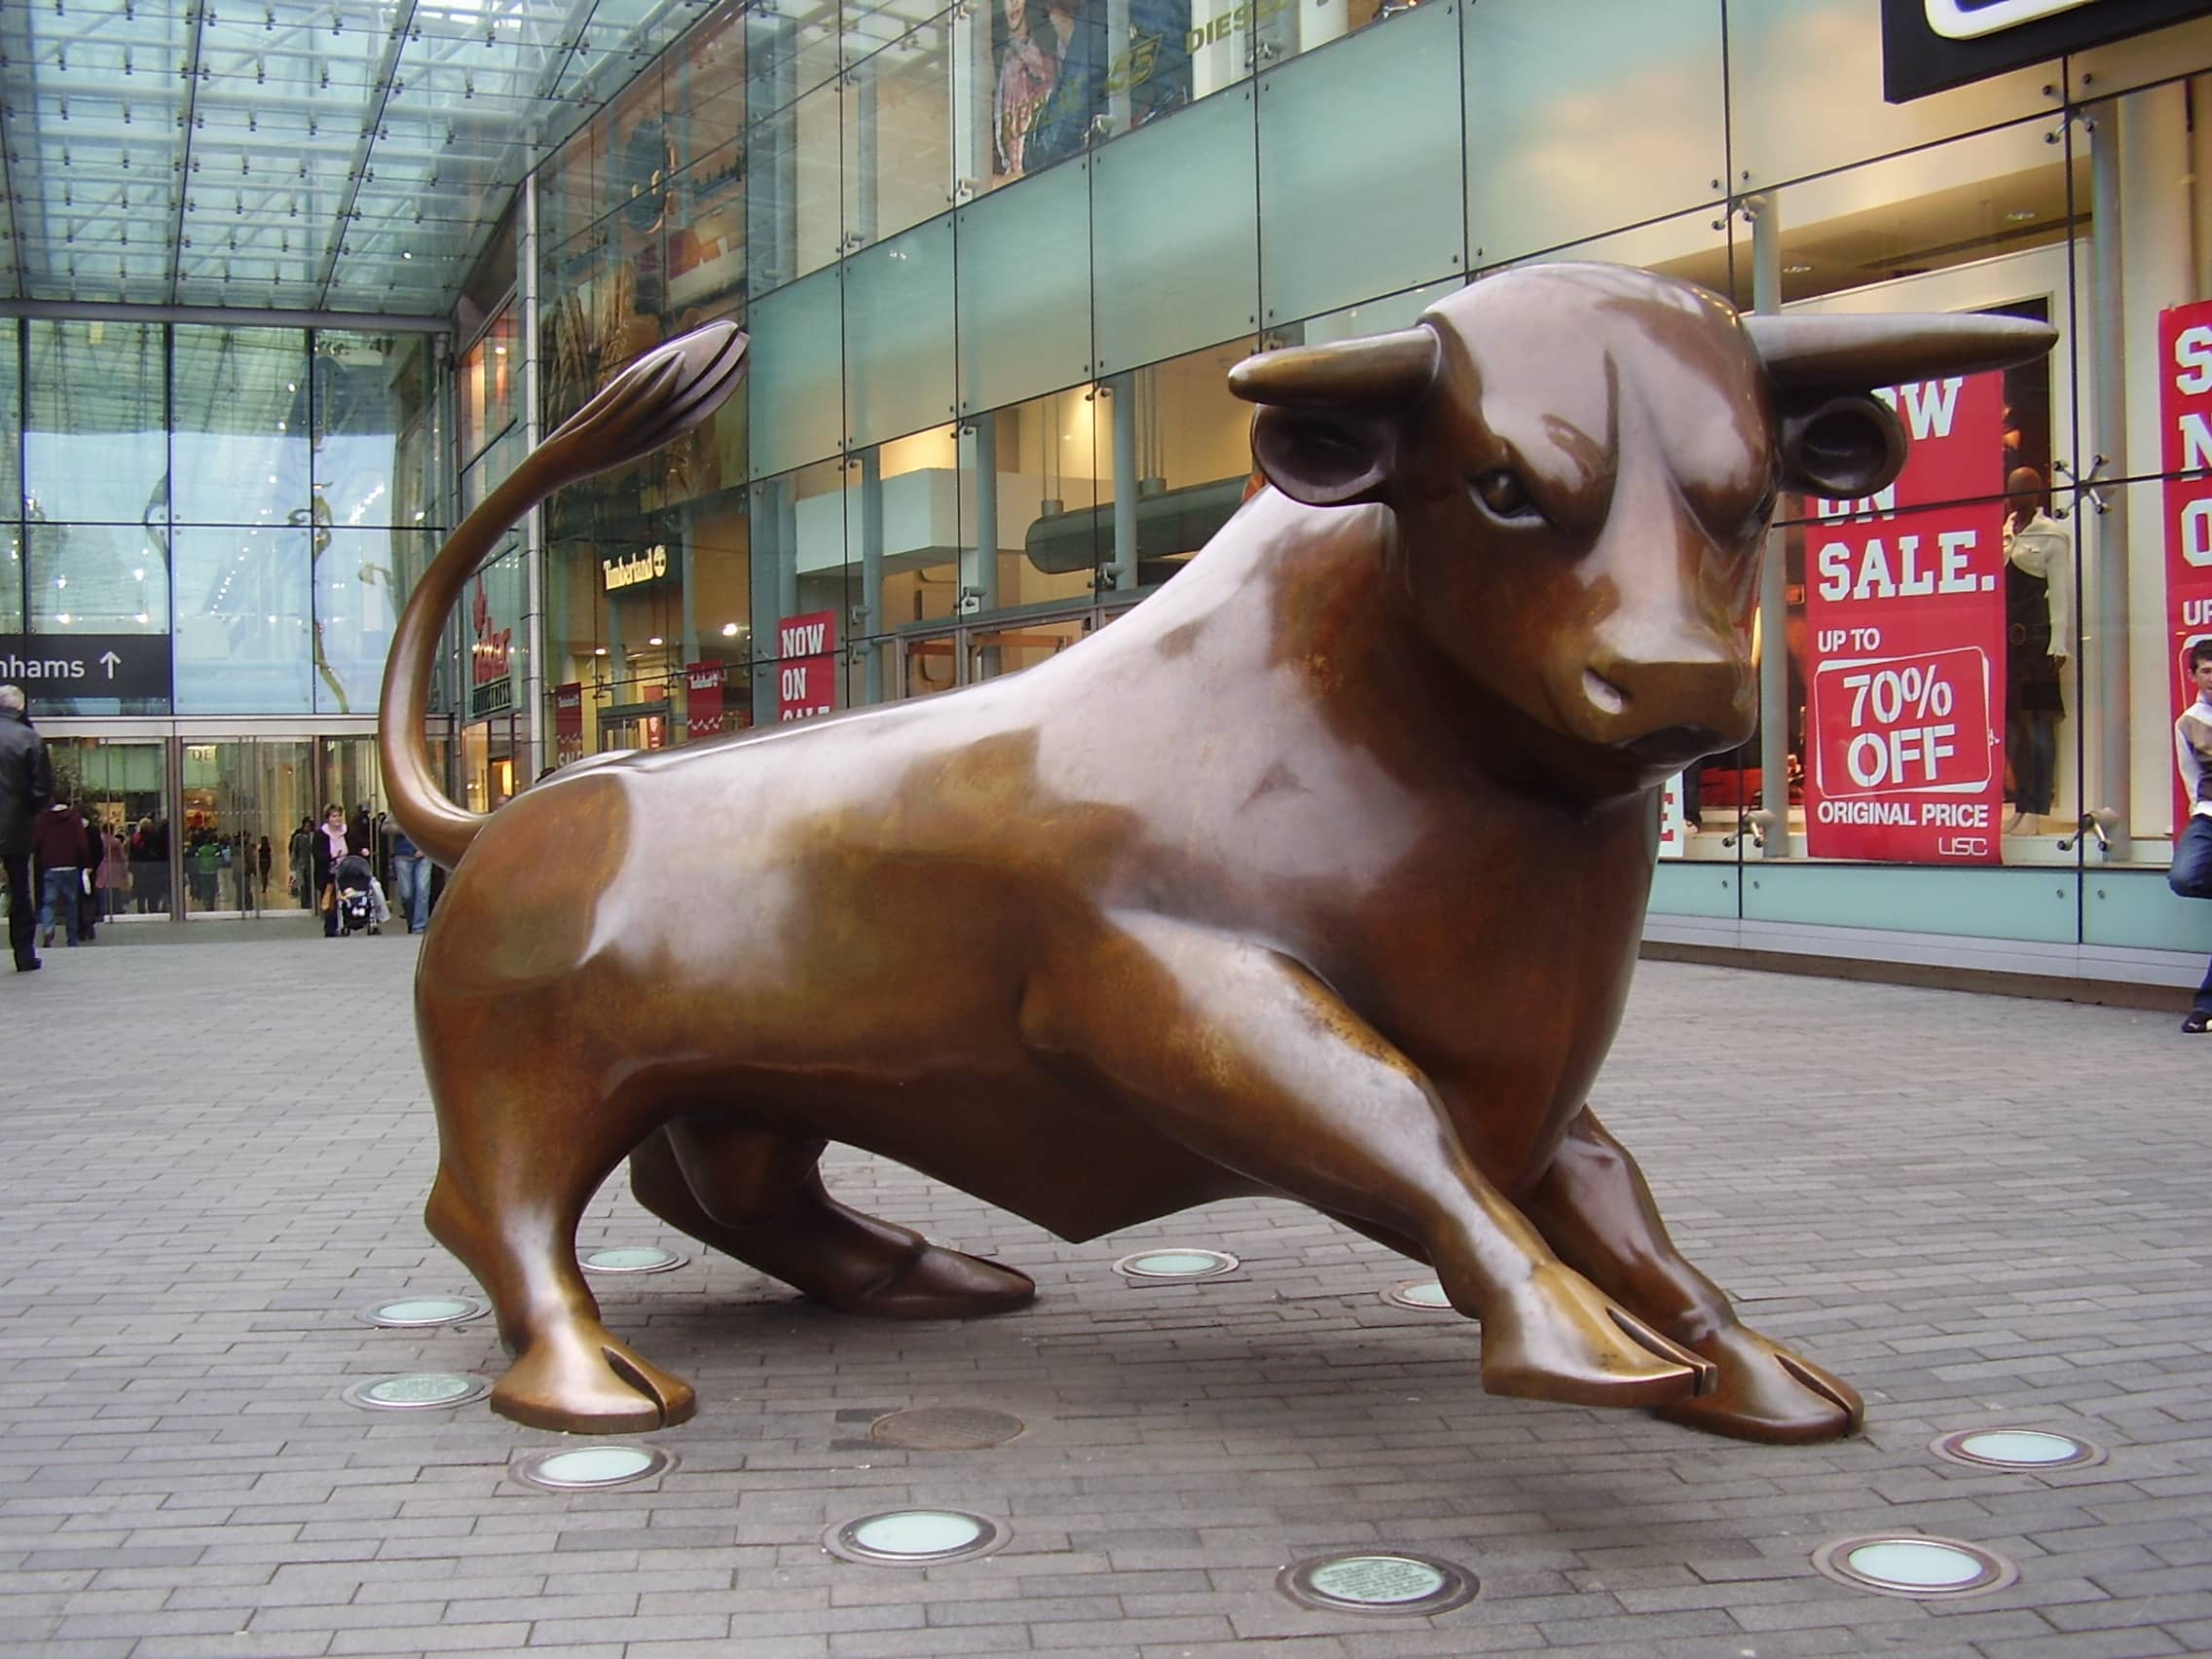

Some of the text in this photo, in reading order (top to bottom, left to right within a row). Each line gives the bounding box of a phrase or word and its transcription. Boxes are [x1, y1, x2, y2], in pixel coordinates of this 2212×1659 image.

[1818, 530, 1995, 602] SALE.
[782, 623, 826, 659] NOW
[1817, 627, 1881, 653] UP TO
[783, 667, 807, 701] ON
[1843, 664, 1953, 728] 70%
[1847, 723, 1956, 789] OFF
[1817, 801, 1989, 828] ORIGINAL PRICE
[1938, 836, 1988, 857] USC
